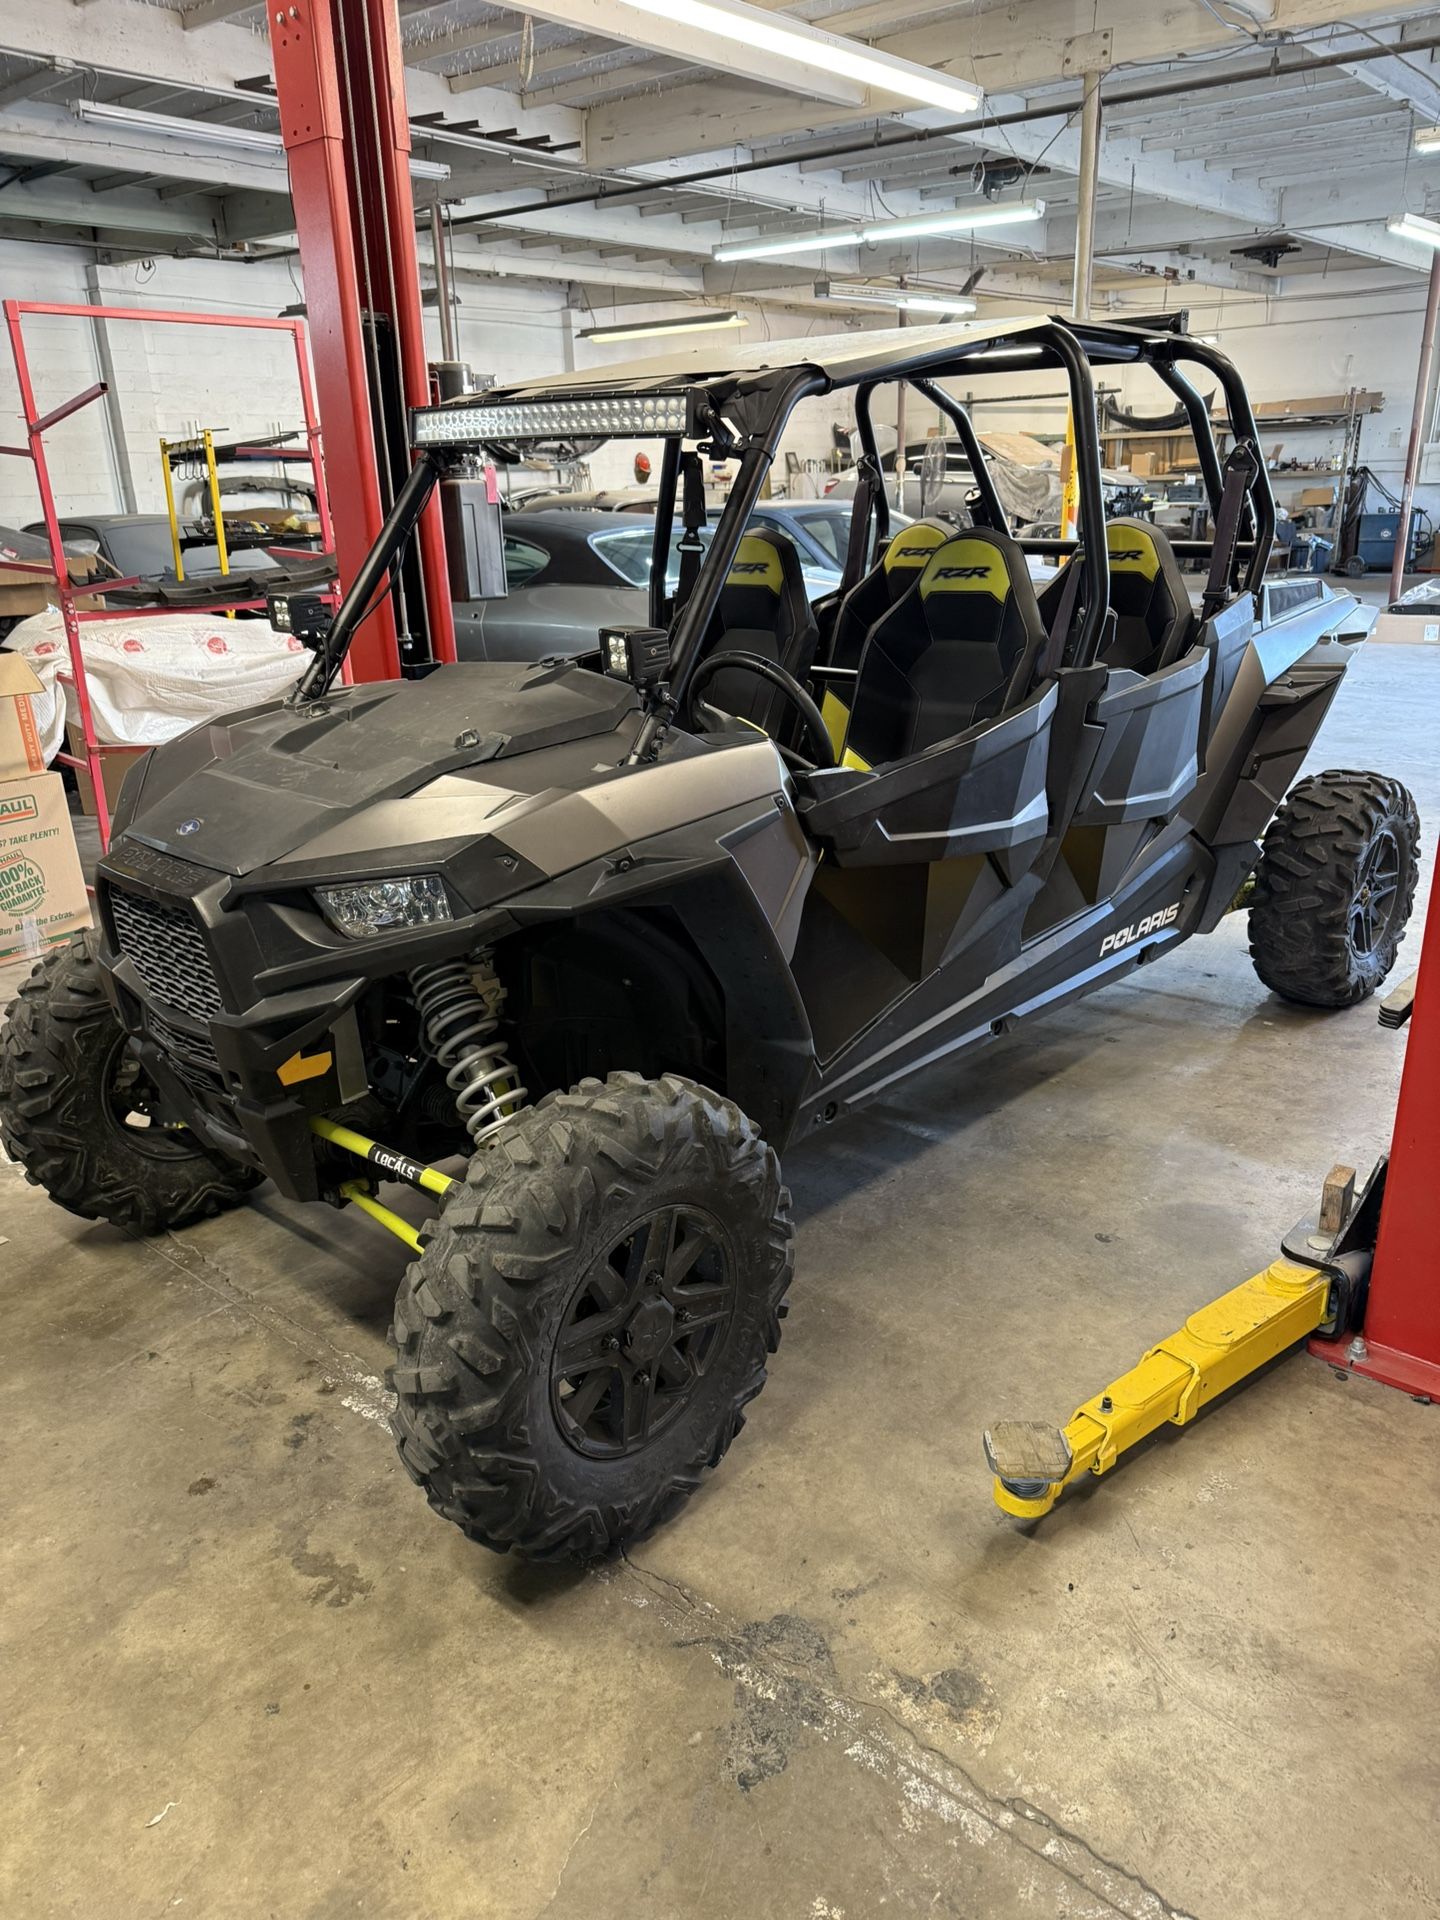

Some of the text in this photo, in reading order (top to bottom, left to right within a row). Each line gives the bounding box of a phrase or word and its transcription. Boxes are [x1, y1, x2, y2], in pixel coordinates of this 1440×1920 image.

[1108, 550, 1144, 562] ZR
[931, 567, 992, 581] RZR
[24, 722, 33, 743] DUTY
[9, 834, 29, 846] TAKE
[30, 827, 60, 841] PLENTY!
[113, 846, 207, 887] POLARIS
[36, 918, 48, 926] the
[50, 911, 75, 922] Extras.
[1099, 902, 1180, 957] POLARIS
